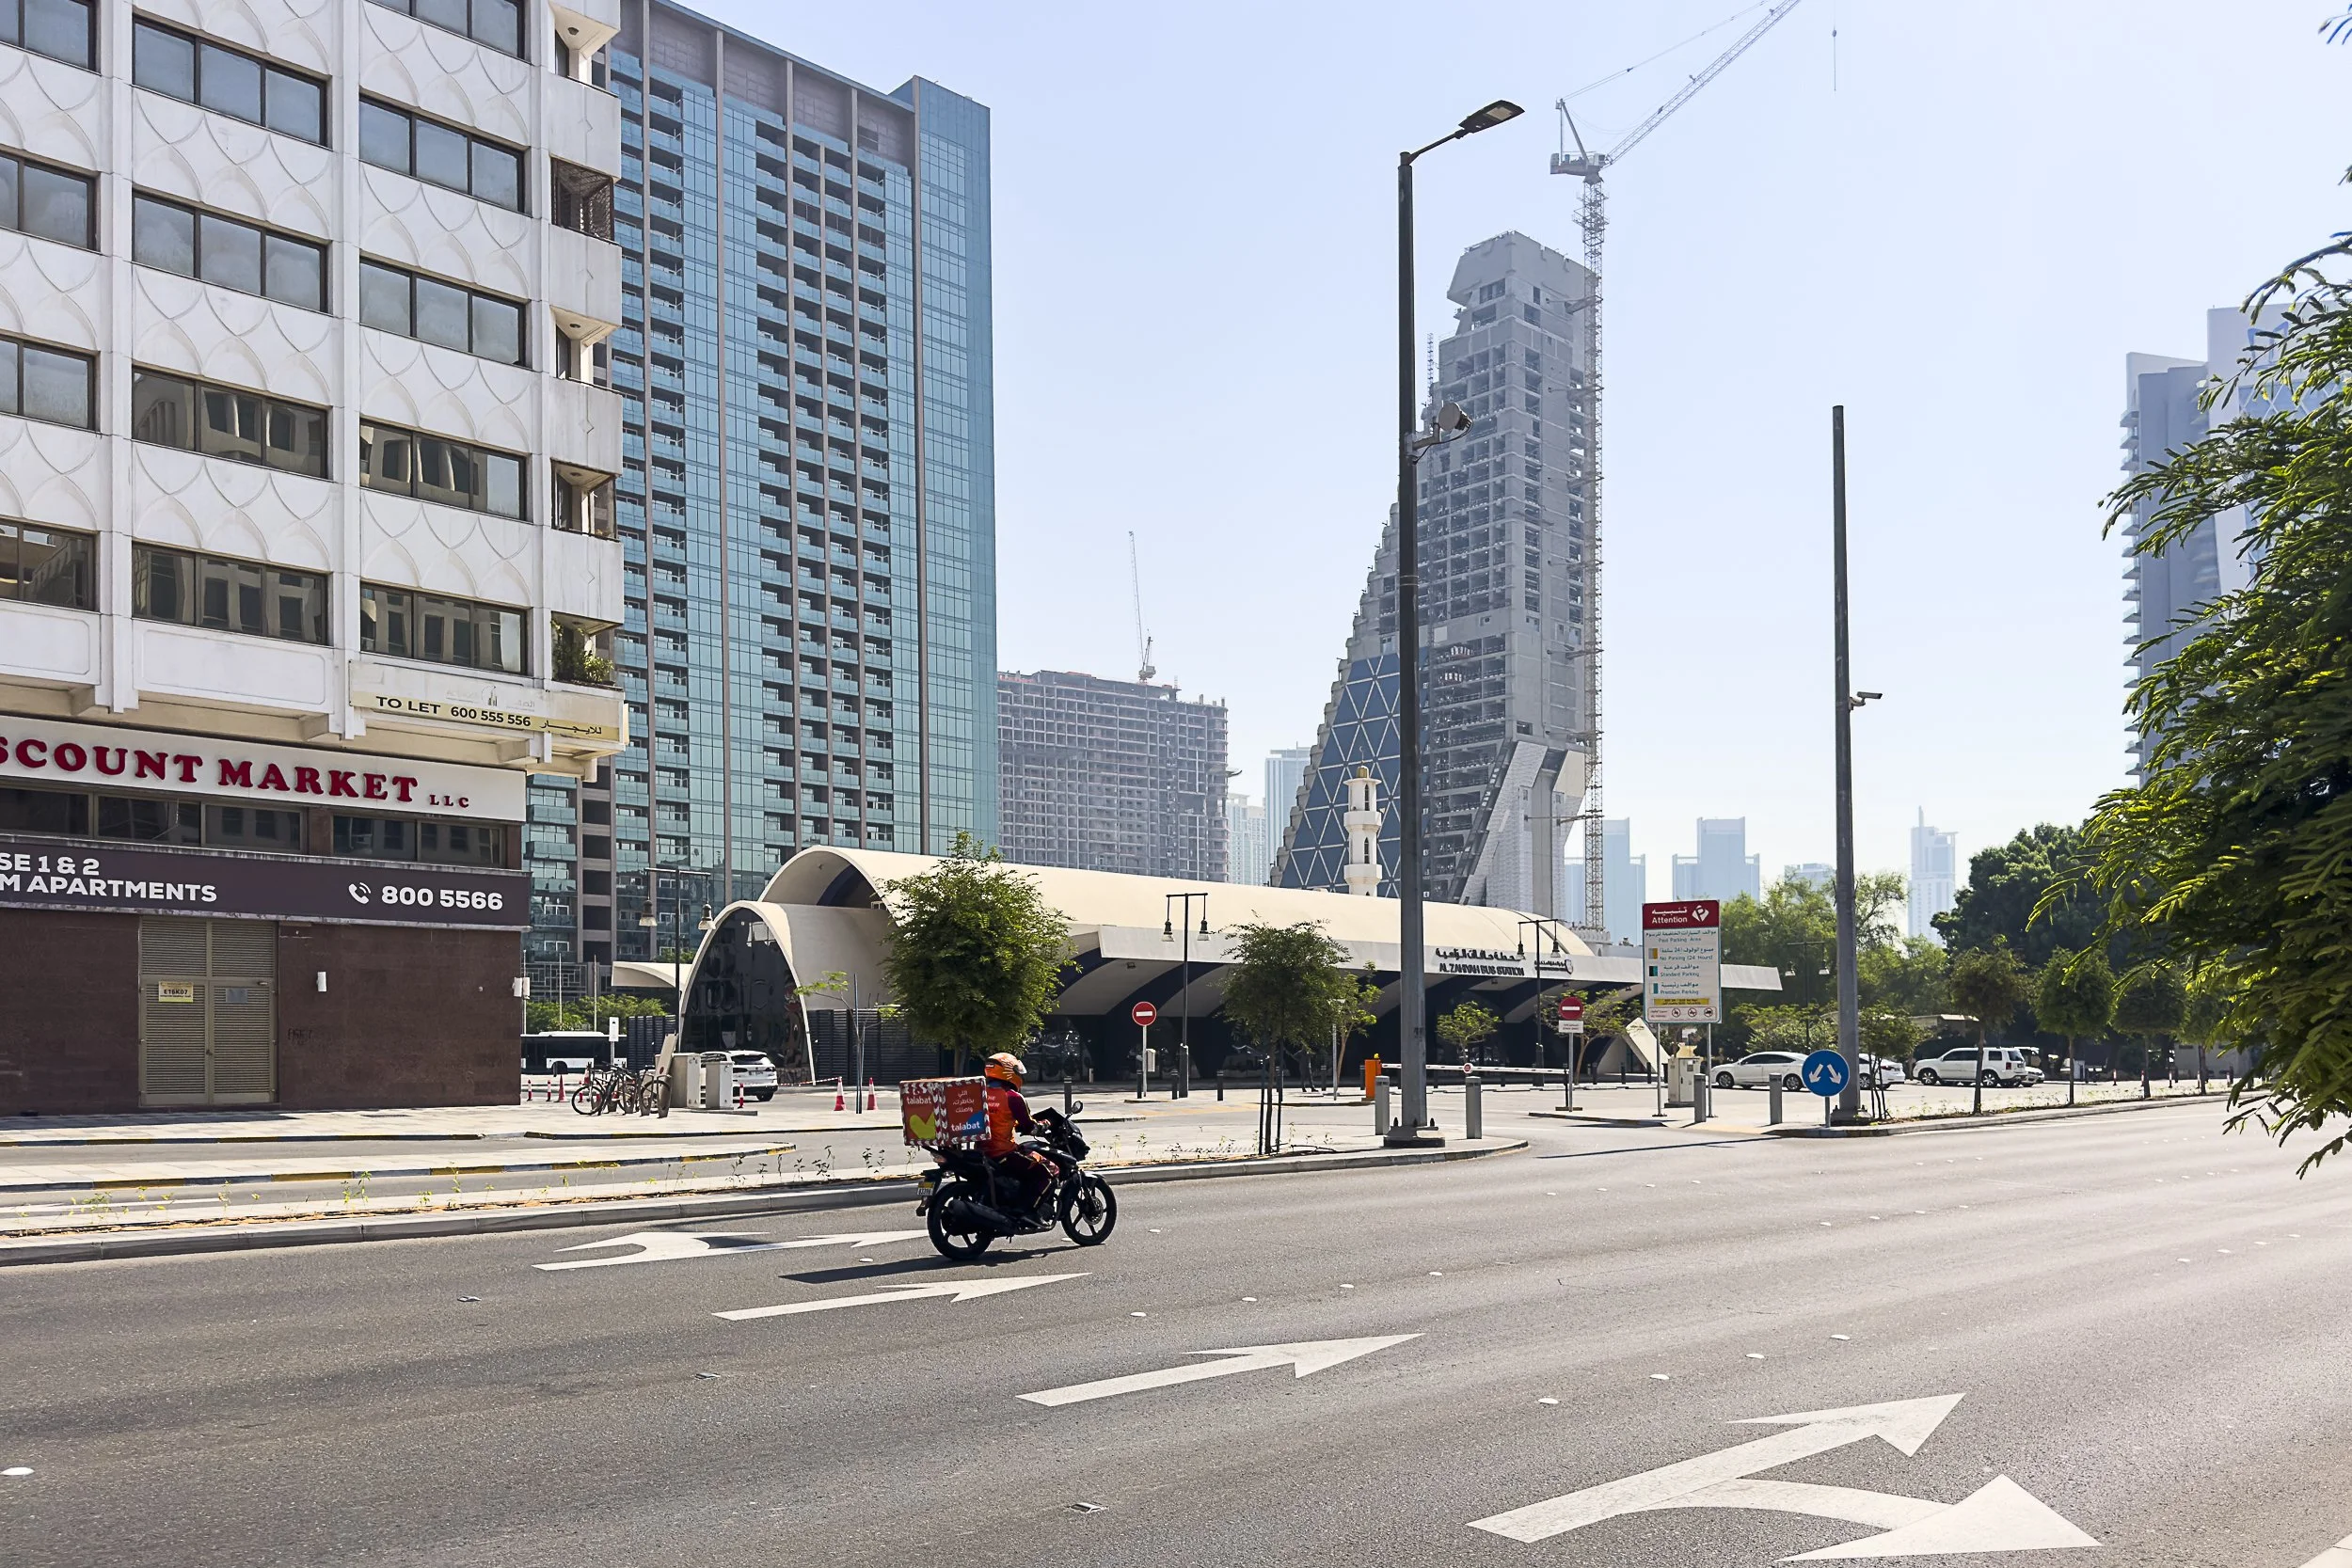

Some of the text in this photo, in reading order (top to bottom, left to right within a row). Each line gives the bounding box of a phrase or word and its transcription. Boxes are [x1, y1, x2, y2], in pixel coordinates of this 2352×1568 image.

[375, 696, 532, 727] TO LET 600 555 556
[217, 758, 419, 802] MARKET
[429, 794, 469, 808] LLC
[38, 855, 51, 874] 1
[56, 856, 76, 876] &
[82, 858, 100, 877] 2
[26, 875, 217, 903] APARTMENTS
[381, 885, 503, 911] 800 5566
[1651, 906, 1688, 916] تنبيه
[1439, 962, 1450, 973] AL
[1480, 965, 1497, 975] BUS
[1497, 966, 1525, 976] STATION
[906, 1096, 932, 1105] talabat
[950, 1121, 980, 1132] talabat
